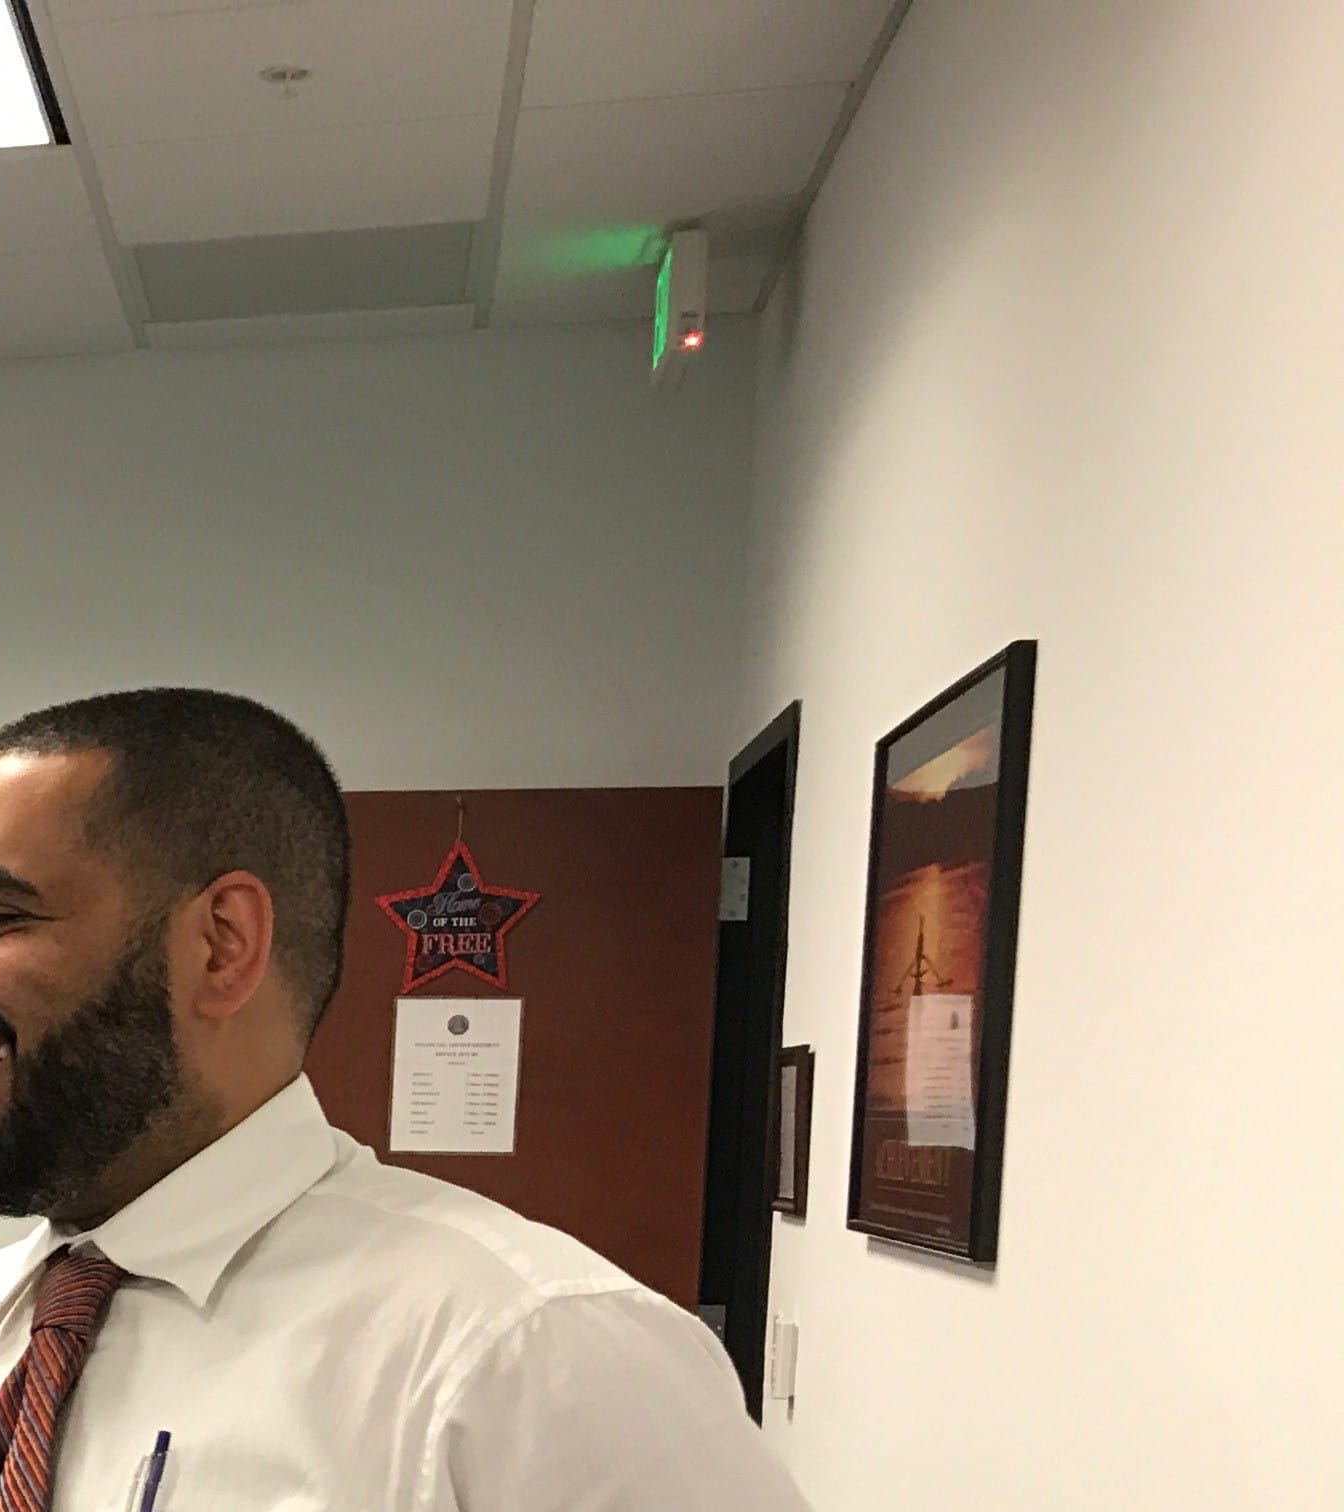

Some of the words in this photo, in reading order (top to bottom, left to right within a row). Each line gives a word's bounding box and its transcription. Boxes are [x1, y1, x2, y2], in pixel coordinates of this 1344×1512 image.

[426, 890, 481, 916] Home
[433, 917, 448, 927] OF
[451, 917, 477, 927] THE
[421, 933, 491, 956] FREE
